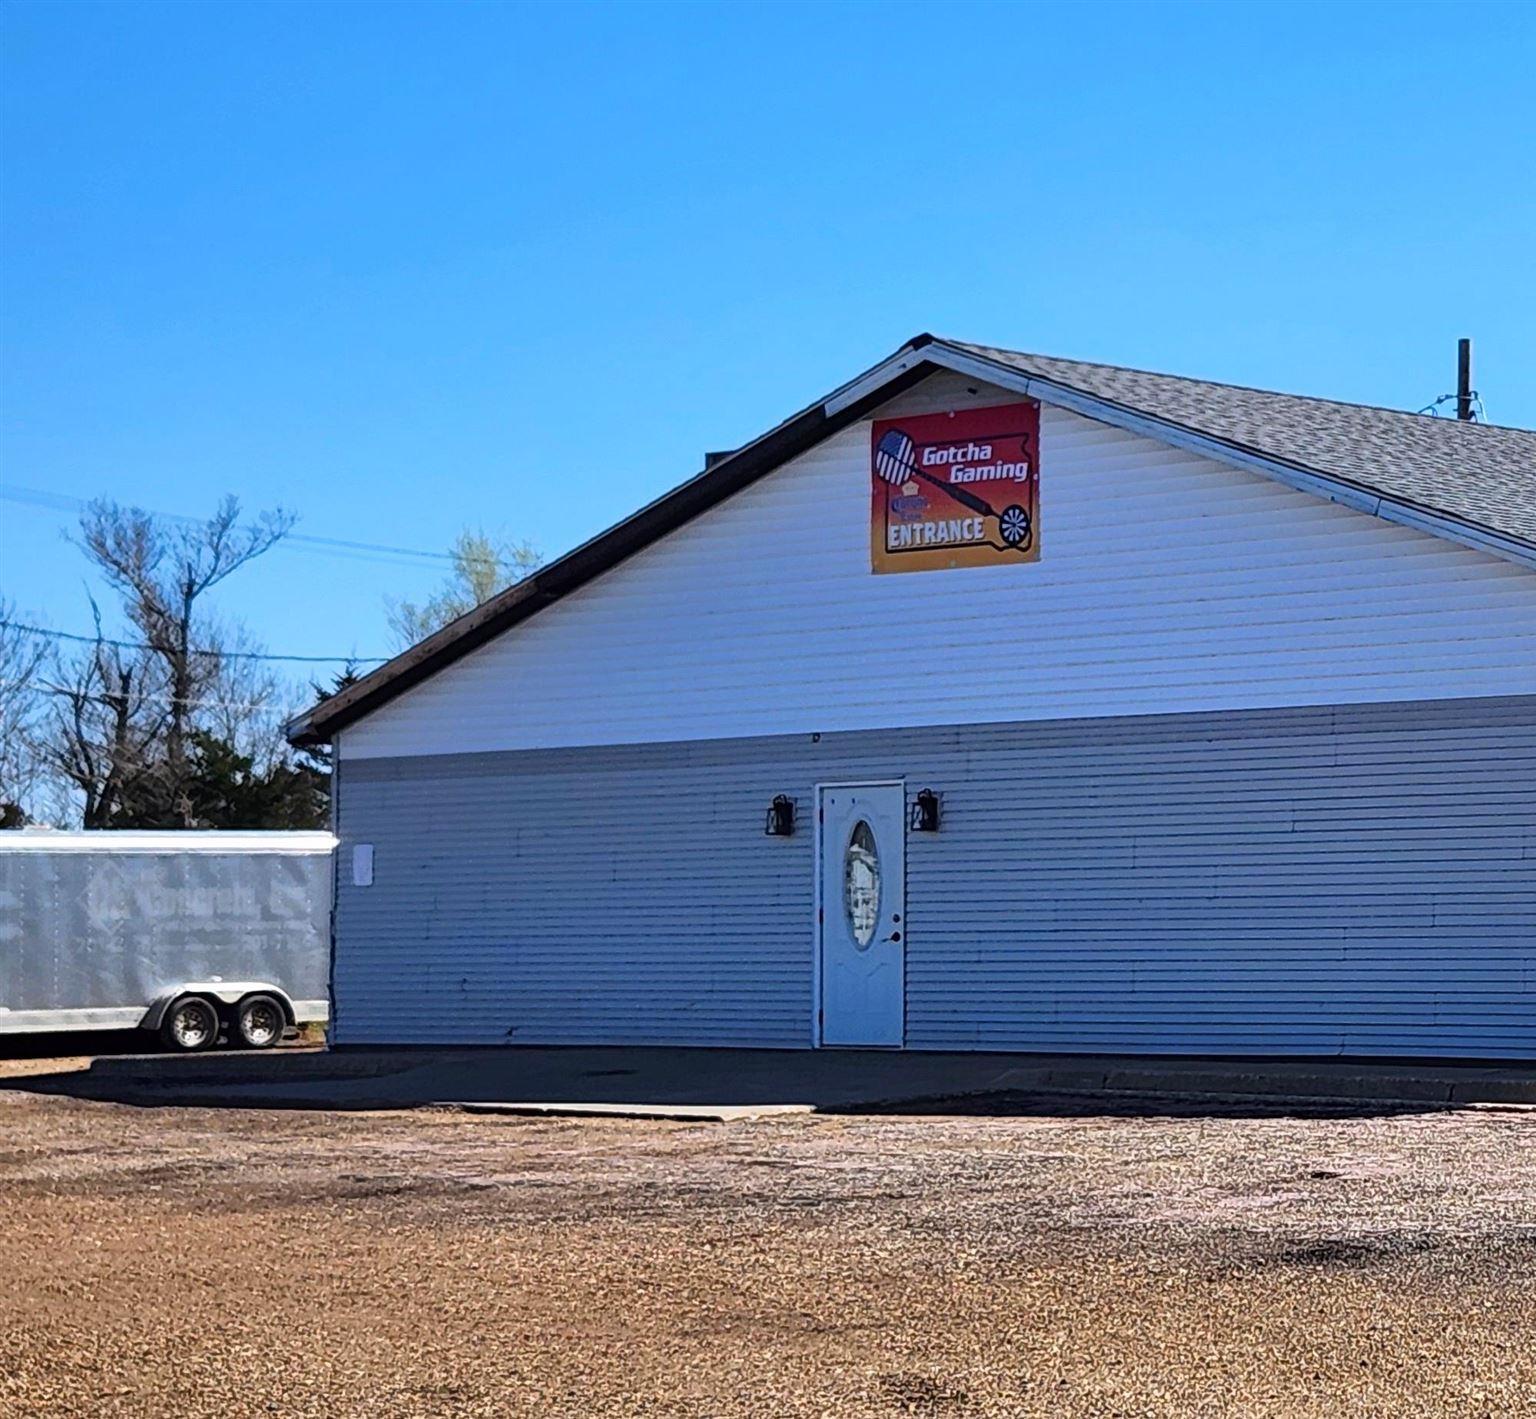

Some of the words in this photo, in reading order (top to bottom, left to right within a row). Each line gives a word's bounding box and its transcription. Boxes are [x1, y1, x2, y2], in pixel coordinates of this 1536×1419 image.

[922, 443, 992, 466] Gotcha
[950, 460, 1029, 484] Gaming
[889, 517, 985, 548] ENTRANCE
